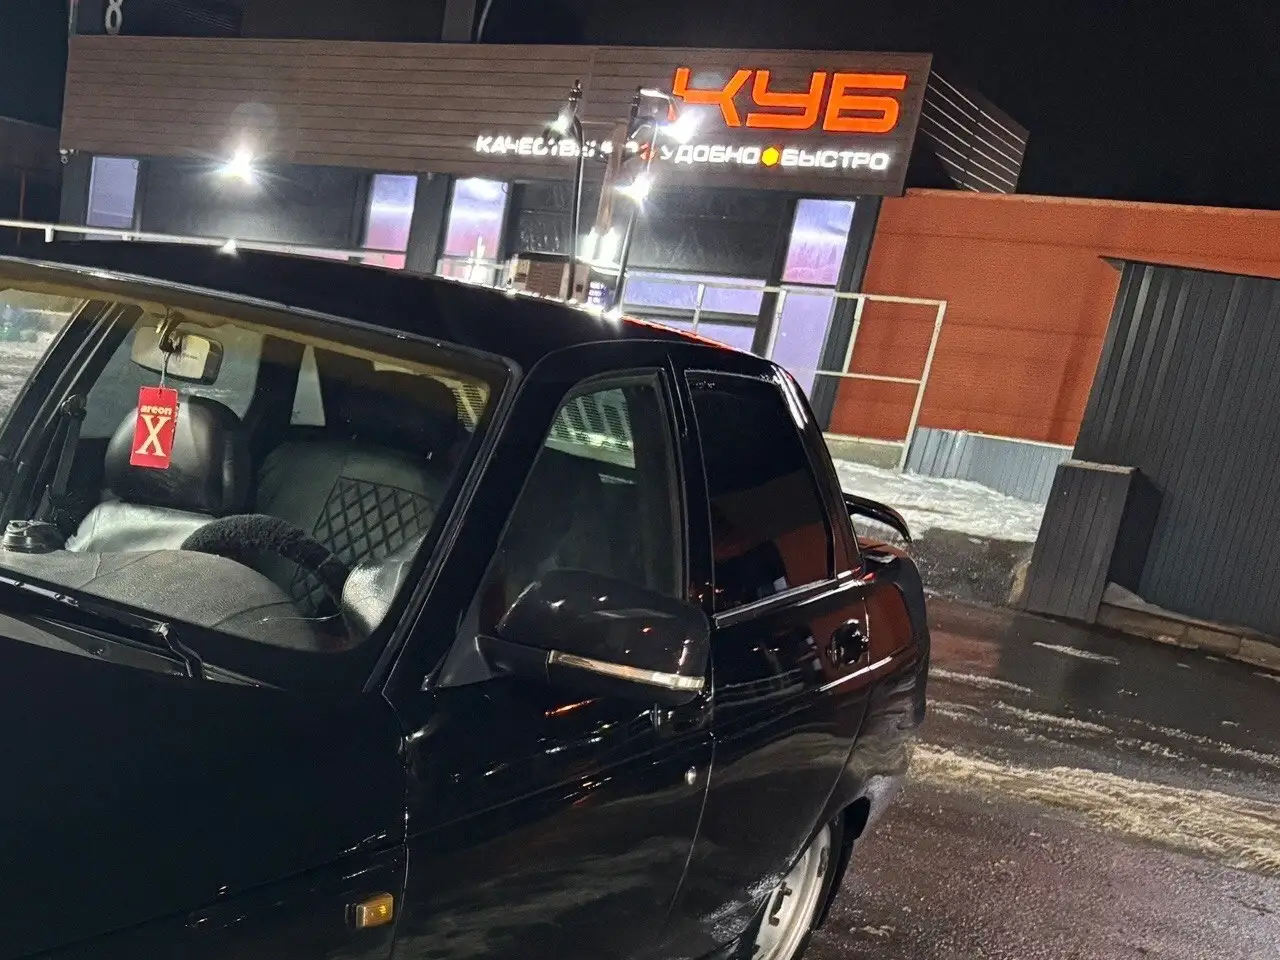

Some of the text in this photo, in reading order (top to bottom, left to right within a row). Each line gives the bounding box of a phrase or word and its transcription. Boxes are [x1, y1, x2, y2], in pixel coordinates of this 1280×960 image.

[673, 68, 907, 132] КУБ
[781, 148, 891, 170] БЫСТРО
[135, 415, 171, 457] X
